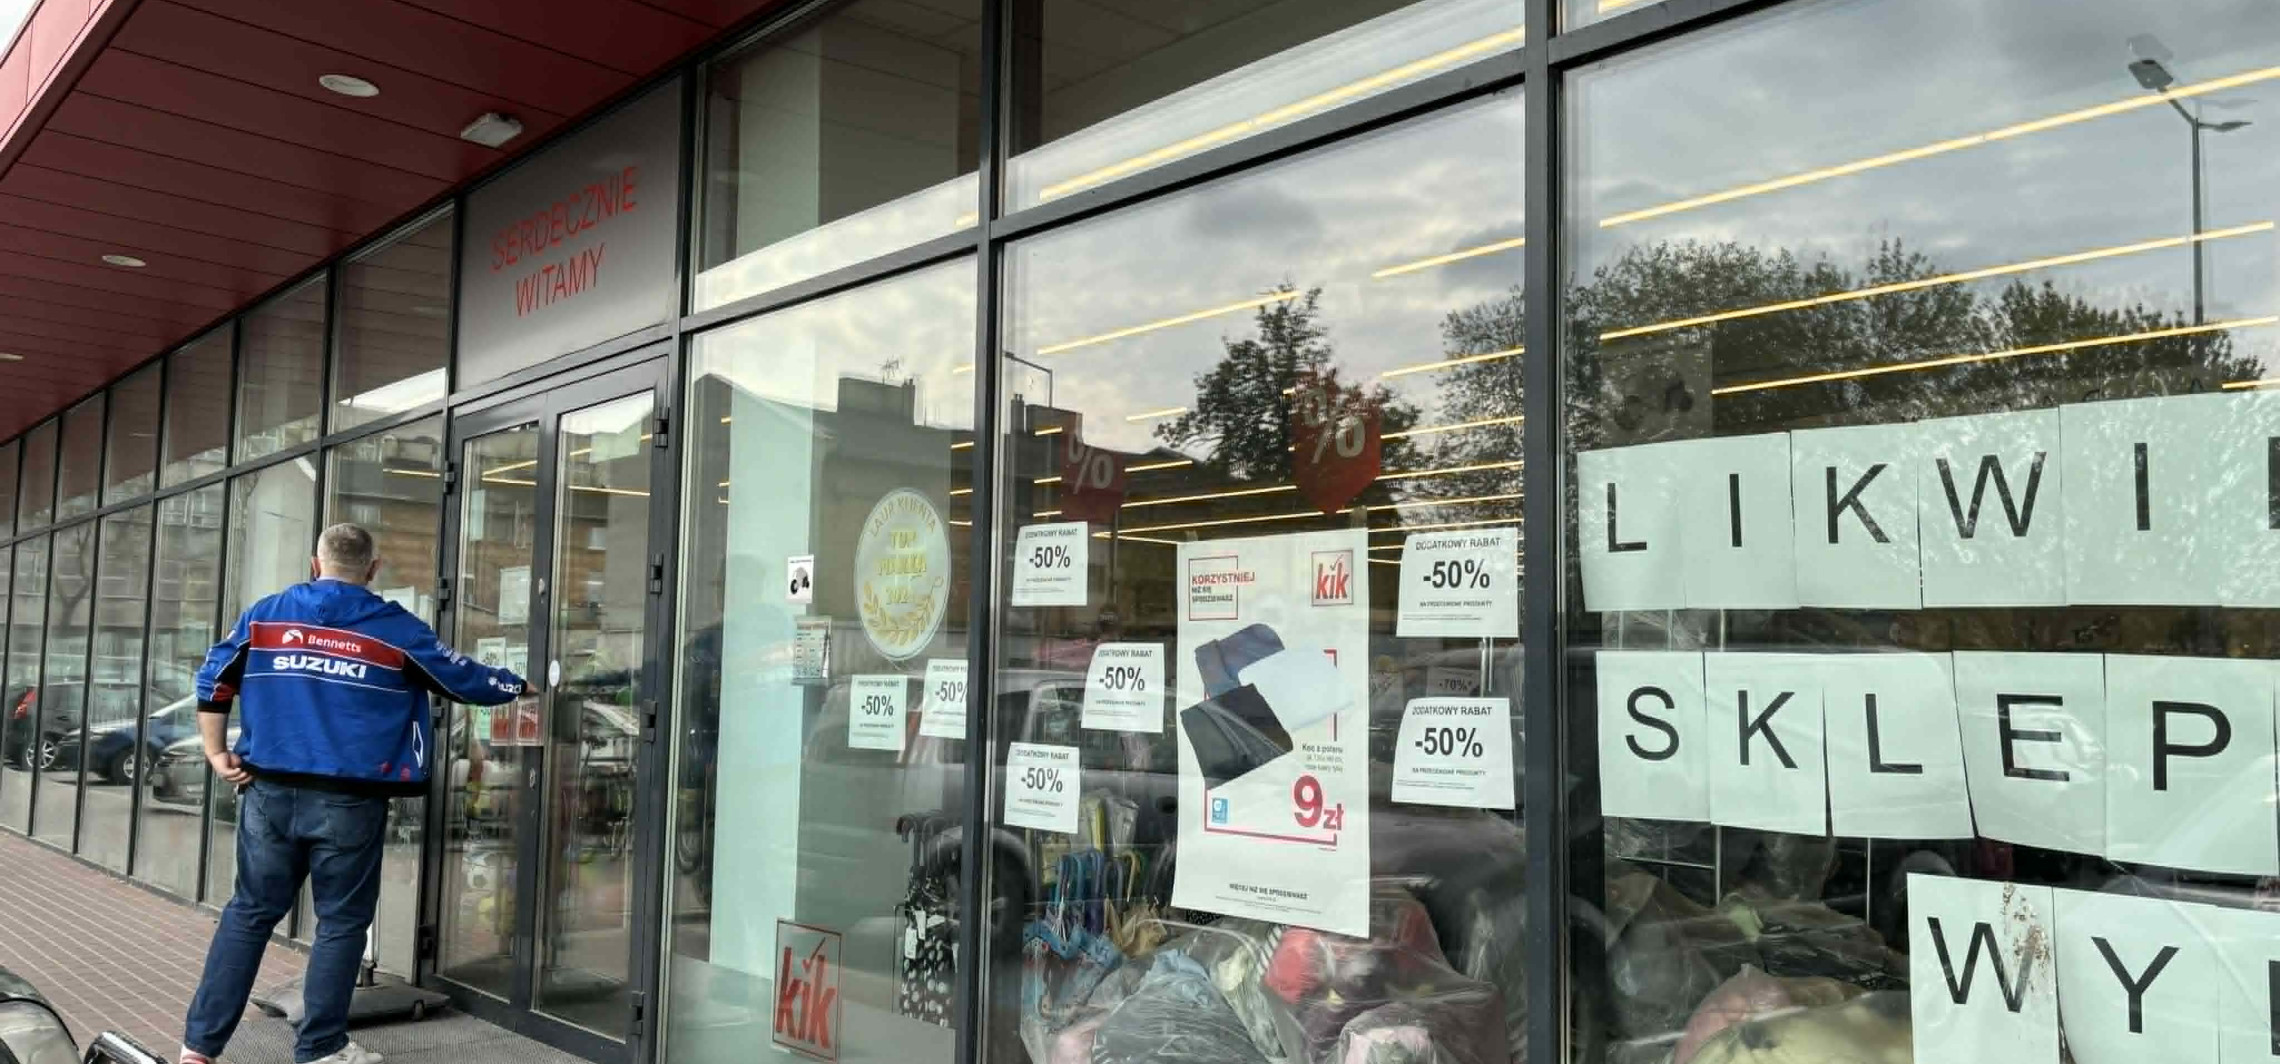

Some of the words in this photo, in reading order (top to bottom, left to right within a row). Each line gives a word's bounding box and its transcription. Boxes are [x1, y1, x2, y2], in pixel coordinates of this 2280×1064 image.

[490, 166, 638, 273] SERDECZNIE
[516, 242, 606, 317] WITAMY
[1607, 437, 2280, 552] LIKWI
[1029, 545, 1071, 568] -50%
[1415, 540, 1468, 551] DODATKOWY
[1470, 537, 1501, 547] RABAT
[1192, 571, 1255, 585] KORZYSTNIEJ
[1315, 554, 1350, 600] kik
[1423, 559, 1490, 588] -50%
[308, 634, 362, 653] Bennetts
[273, 655, 367, 679] SUZUKI
[1099, 666, 1145, 691] -50%
[861, 695, 894, 716] -50%
[1461, 706, 1493, 715] RABAT
[1415, 727, 1483, 757] -50%
[1625, 686, 2232, 791] SKLEP
[1021, 768, 1063, 792] -50%
[1294, 775, 1344, 830] 9zł
[775, 938, 836, 1049] kik
[1927, 917, 2280, 1056] WY
